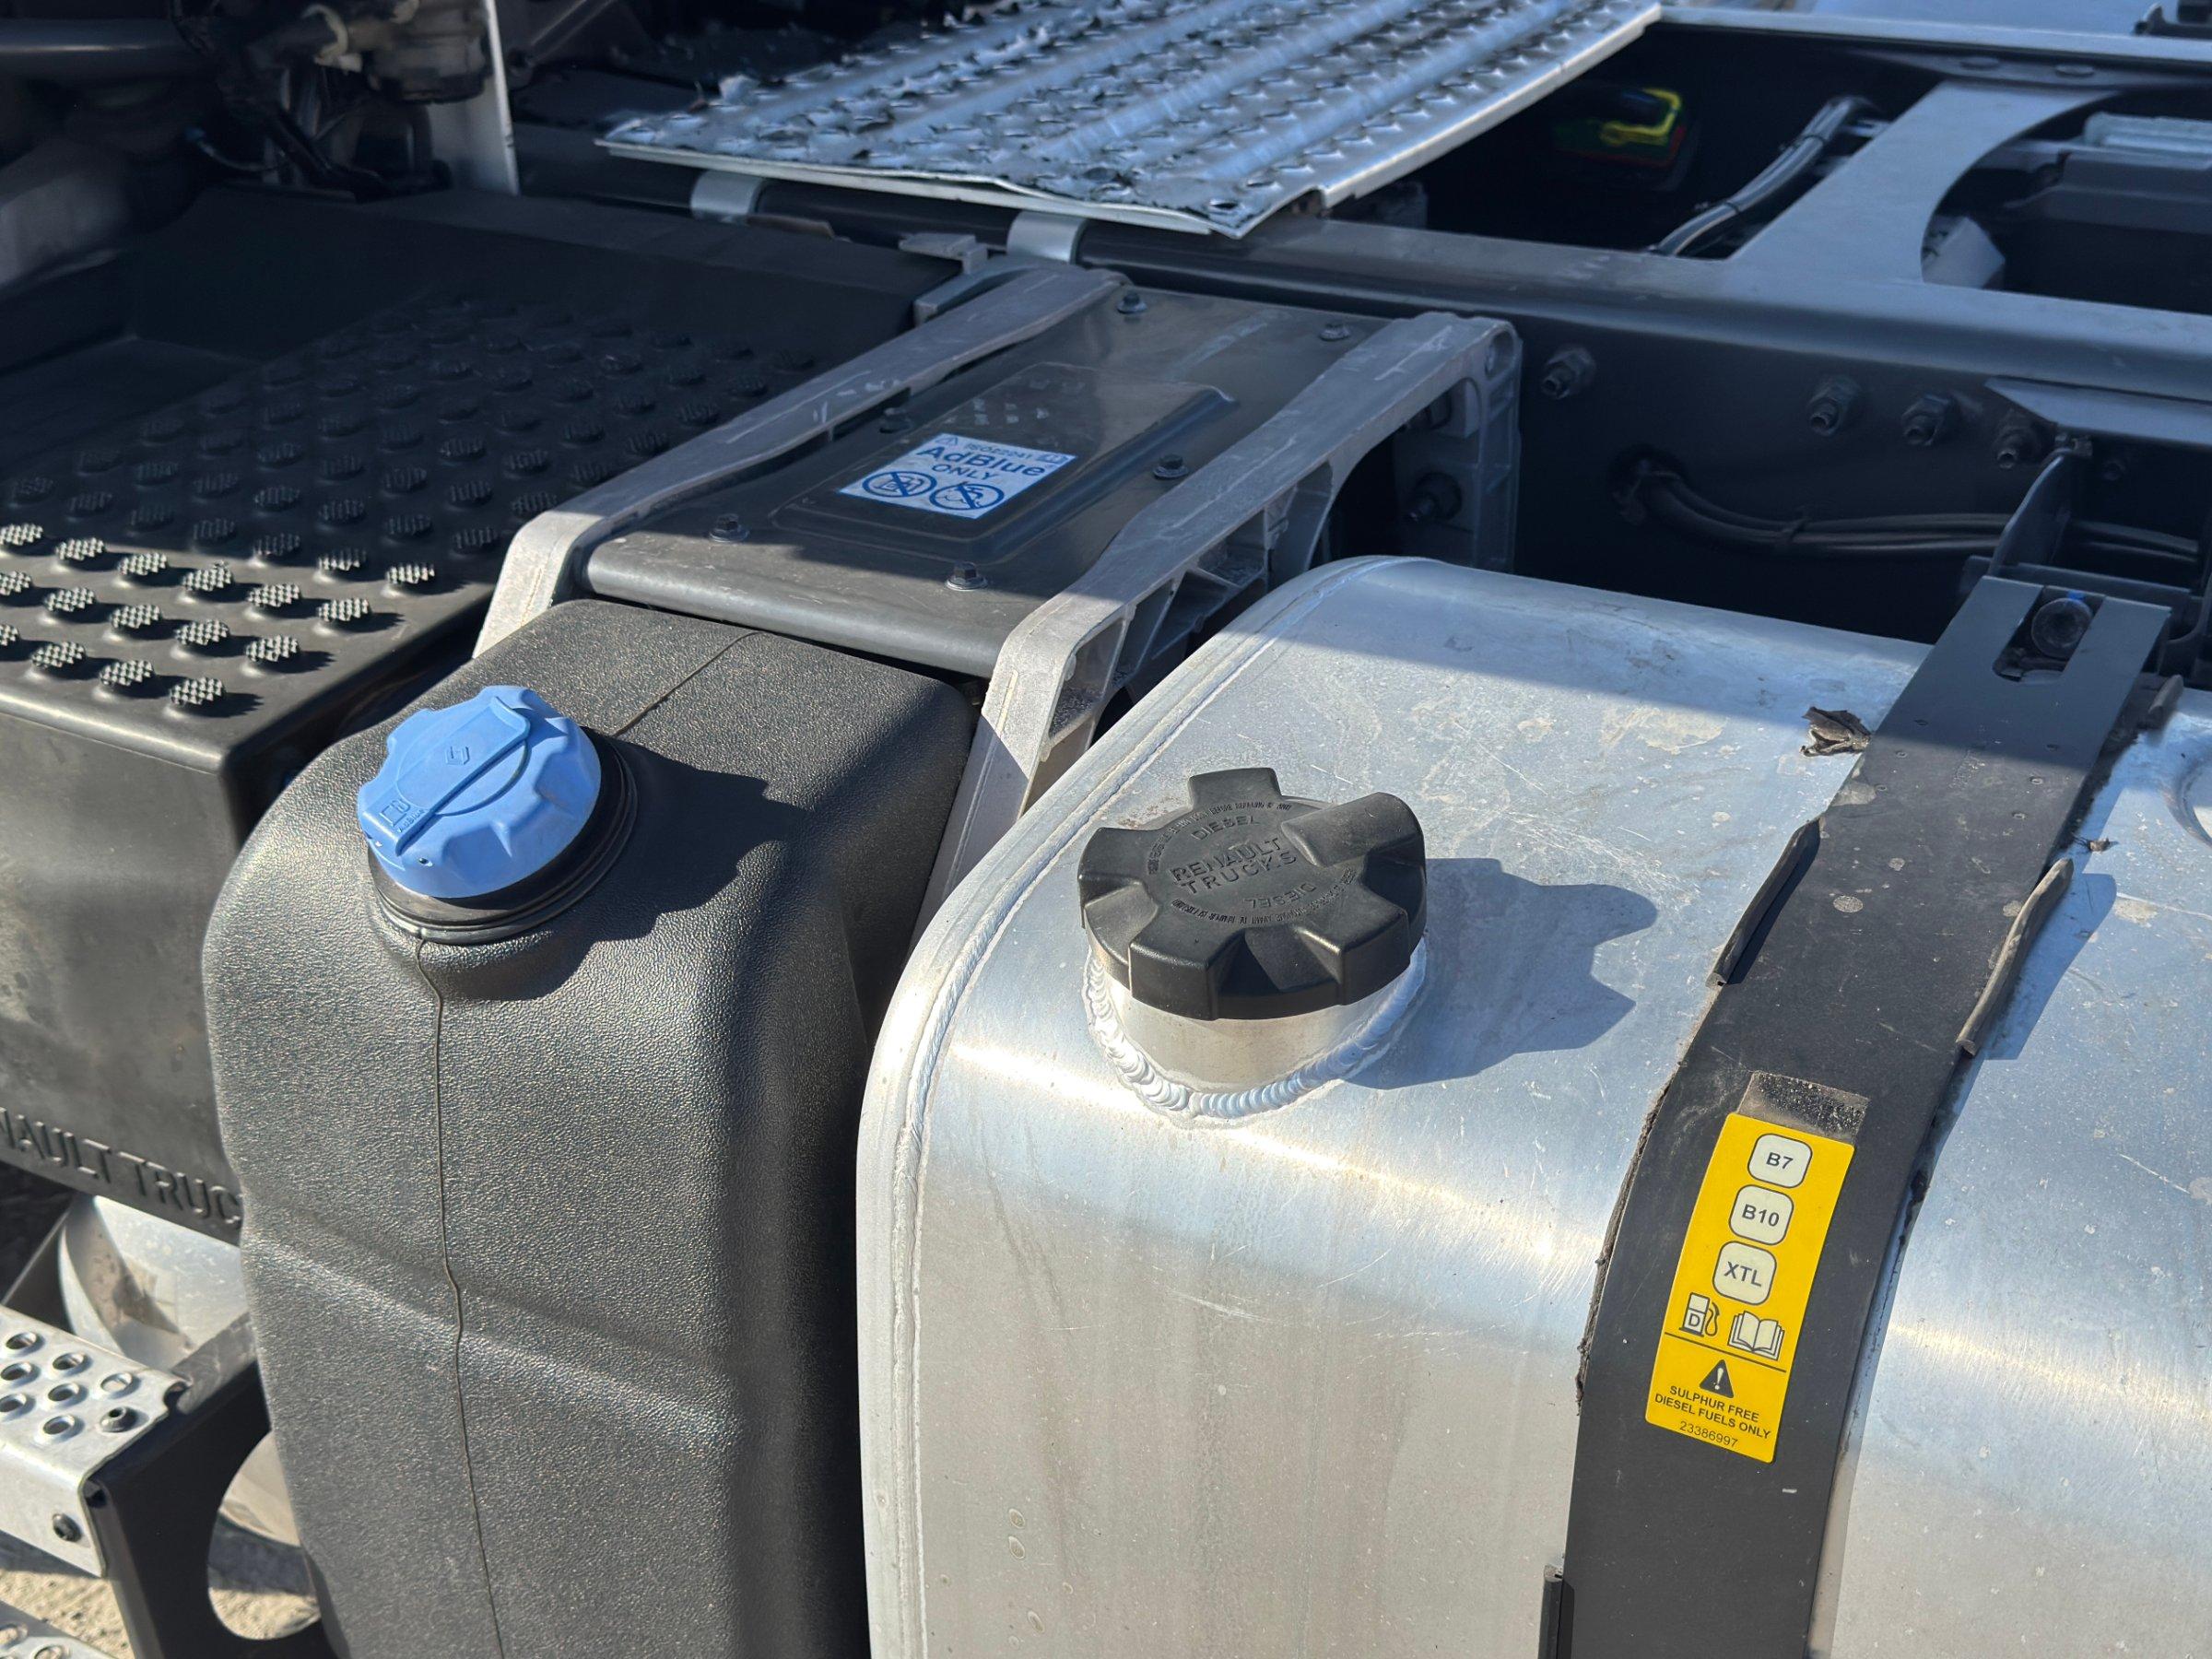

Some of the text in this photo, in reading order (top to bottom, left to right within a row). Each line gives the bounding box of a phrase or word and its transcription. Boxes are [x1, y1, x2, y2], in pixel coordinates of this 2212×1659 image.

[917, 446, 1047, 477] AdBlue
[932, 463, 1001, 480] ONLY
[1190, 813, 1261, 841] DIESEL
[1169, 837, 1282, 882] RENAULT
[1180, 852, 1297, 895] TRUCKS
[1243, 882, 1318, 909] DIESEL
[1765, 1152, 1794, 1170] B7
[1741, 1204, 1781, 1228] B10
[1724, 1261, 1762, 1288] XTL
[1688, 1312, 1701, 1328] D
[1653, 1392, 1772, 1441] DIESEL FUELS ONLY
[1669, 1384, 1760, 1423] SULPHUR FREE
[1678, 1419, 1740, 1448] 23386997
